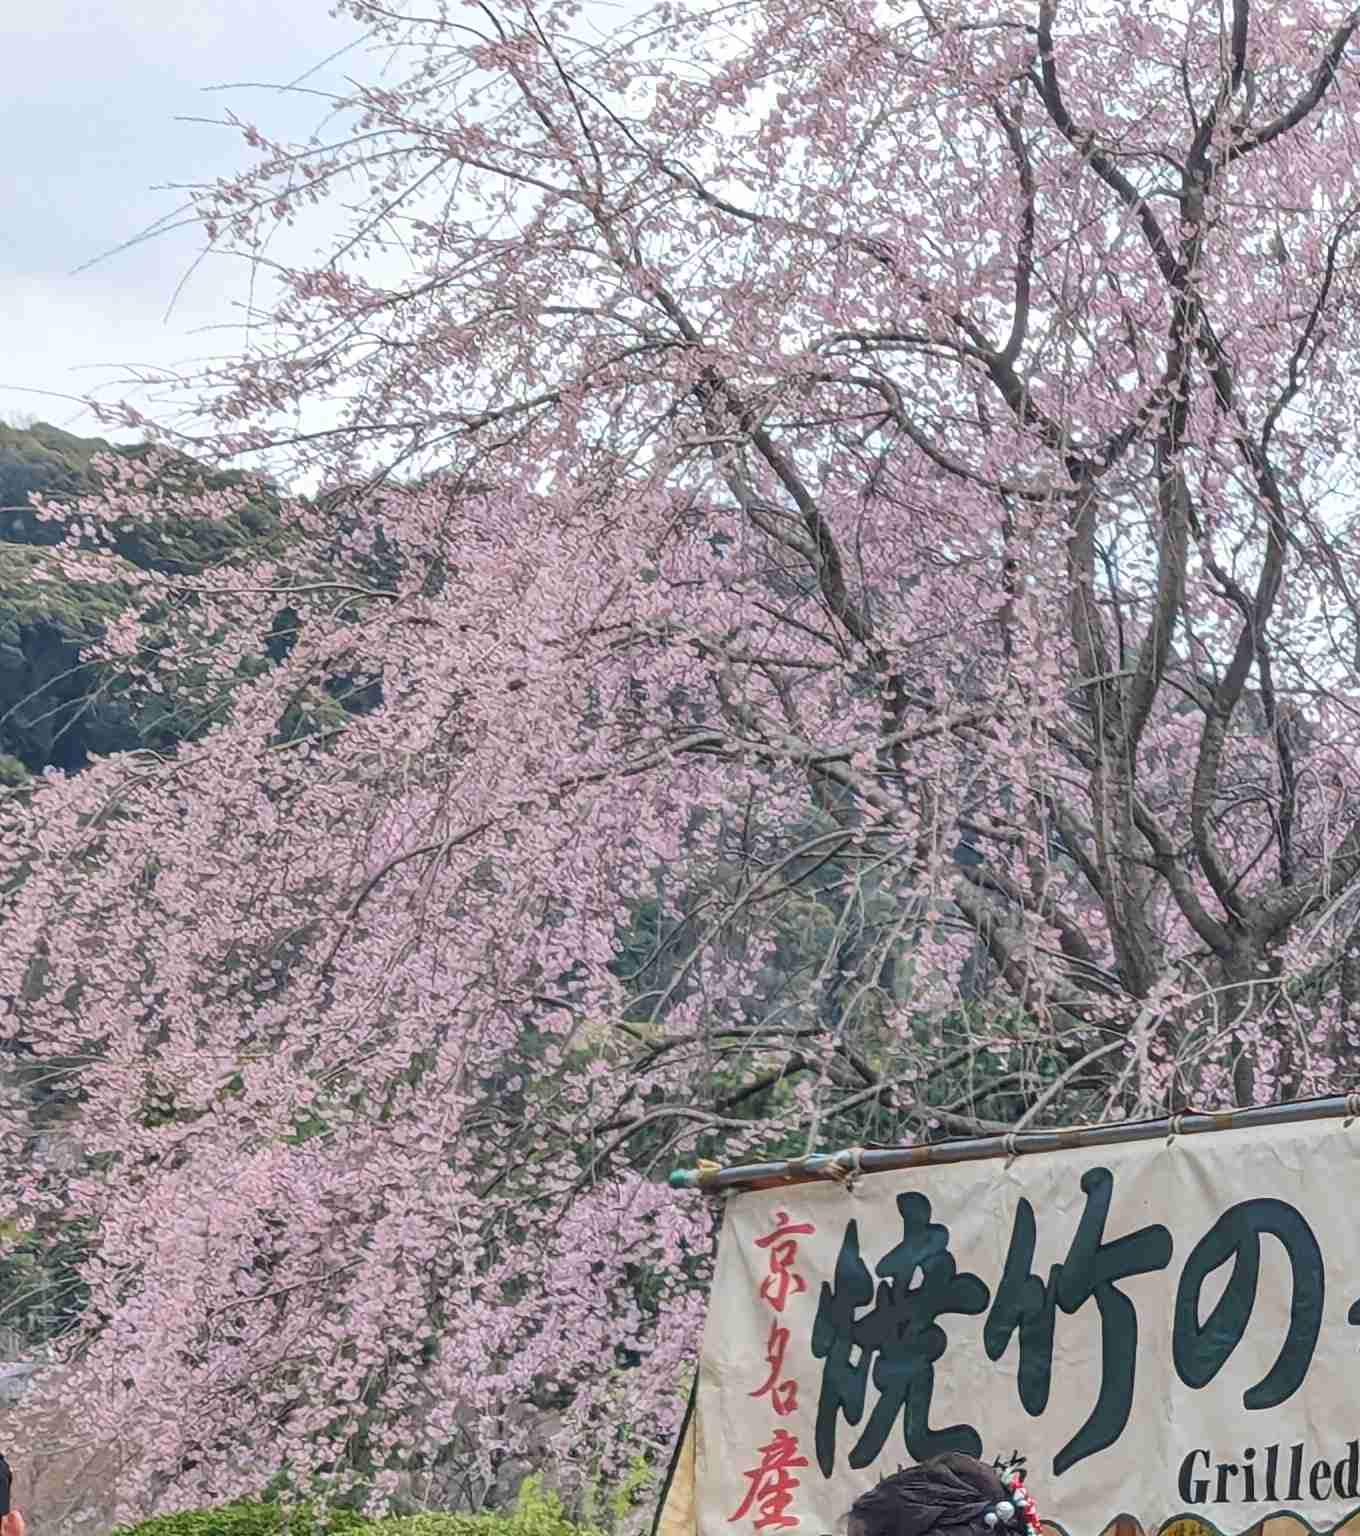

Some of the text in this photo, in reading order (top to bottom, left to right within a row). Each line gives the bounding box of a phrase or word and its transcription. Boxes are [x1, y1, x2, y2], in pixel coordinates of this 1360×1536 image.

[728, 1212, 814, 1530] 京名産
[1177, 1440, 1360, 1504] Grilled
